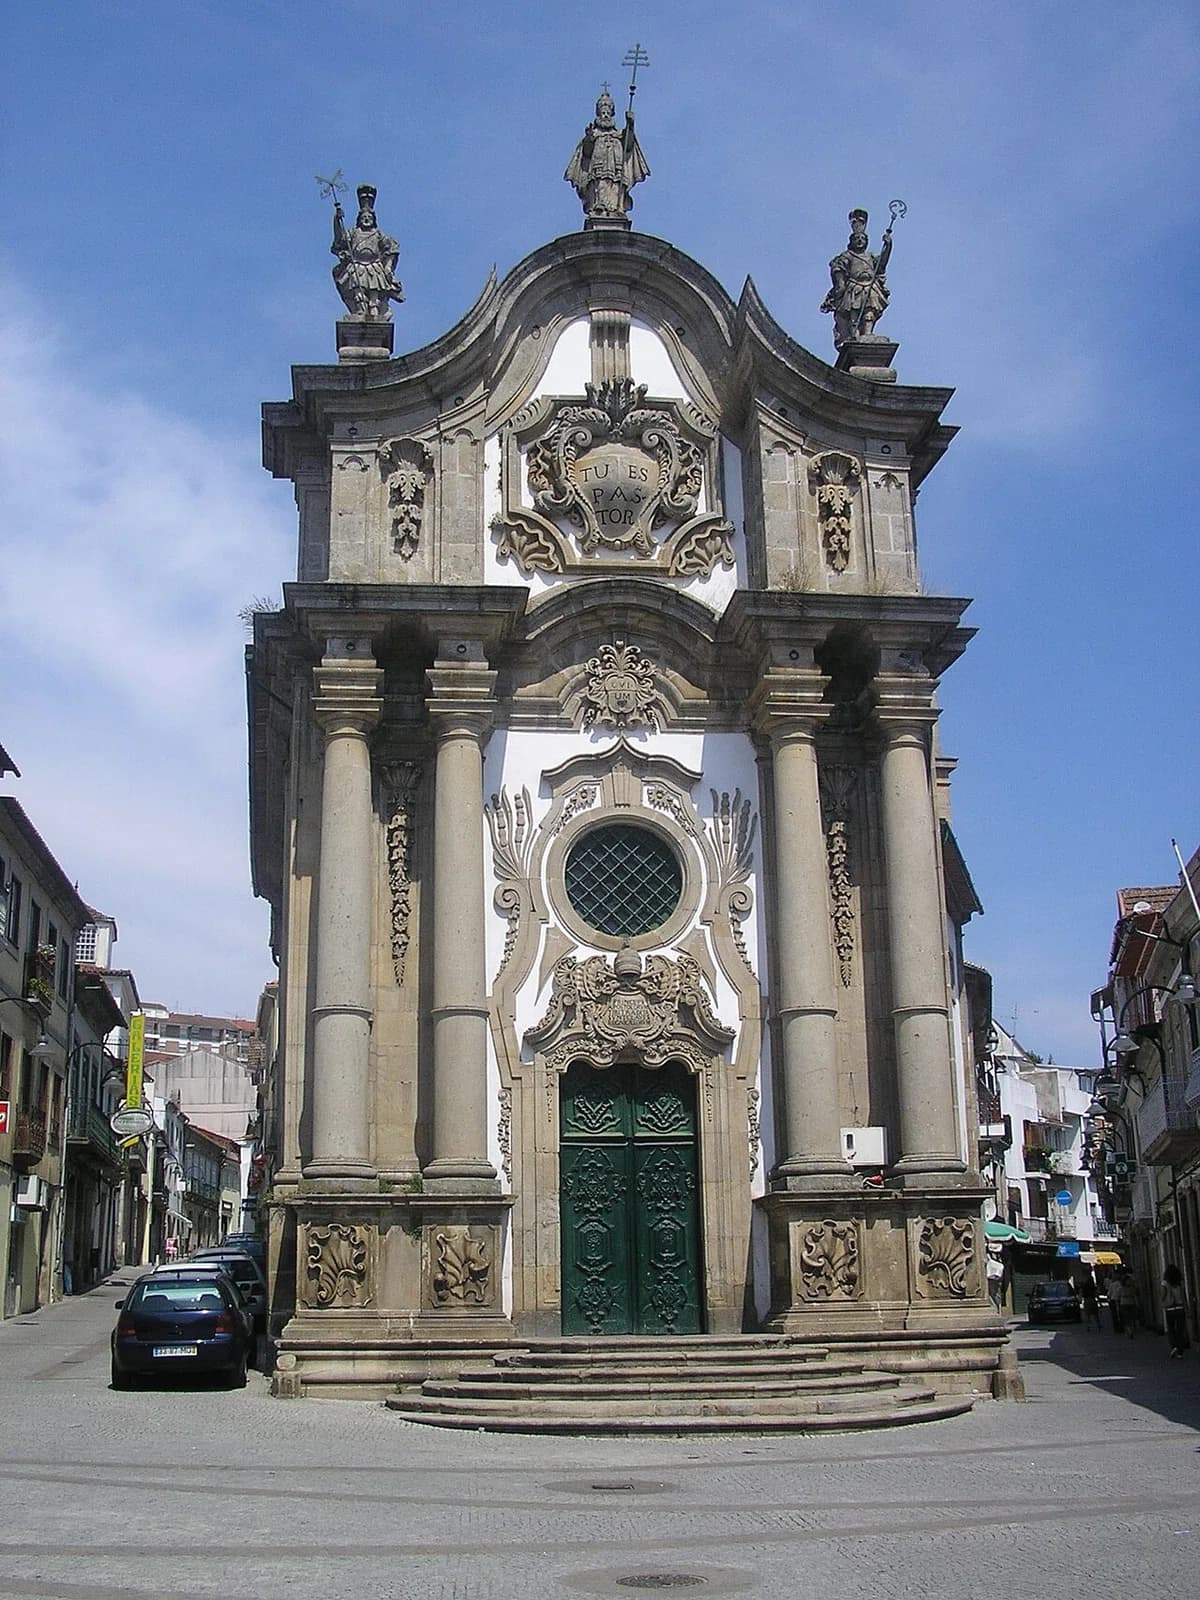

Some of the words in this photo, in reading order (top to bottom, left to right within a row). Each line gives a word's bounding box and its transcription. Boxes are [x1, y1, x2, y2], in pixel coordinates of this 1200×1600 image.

[579, 463, 609, 482] TU
[628, 464, 649, 482] ES
[595, 508, 634, 525] TOR
[128, 1019, 142, 1106] GALERIAS
